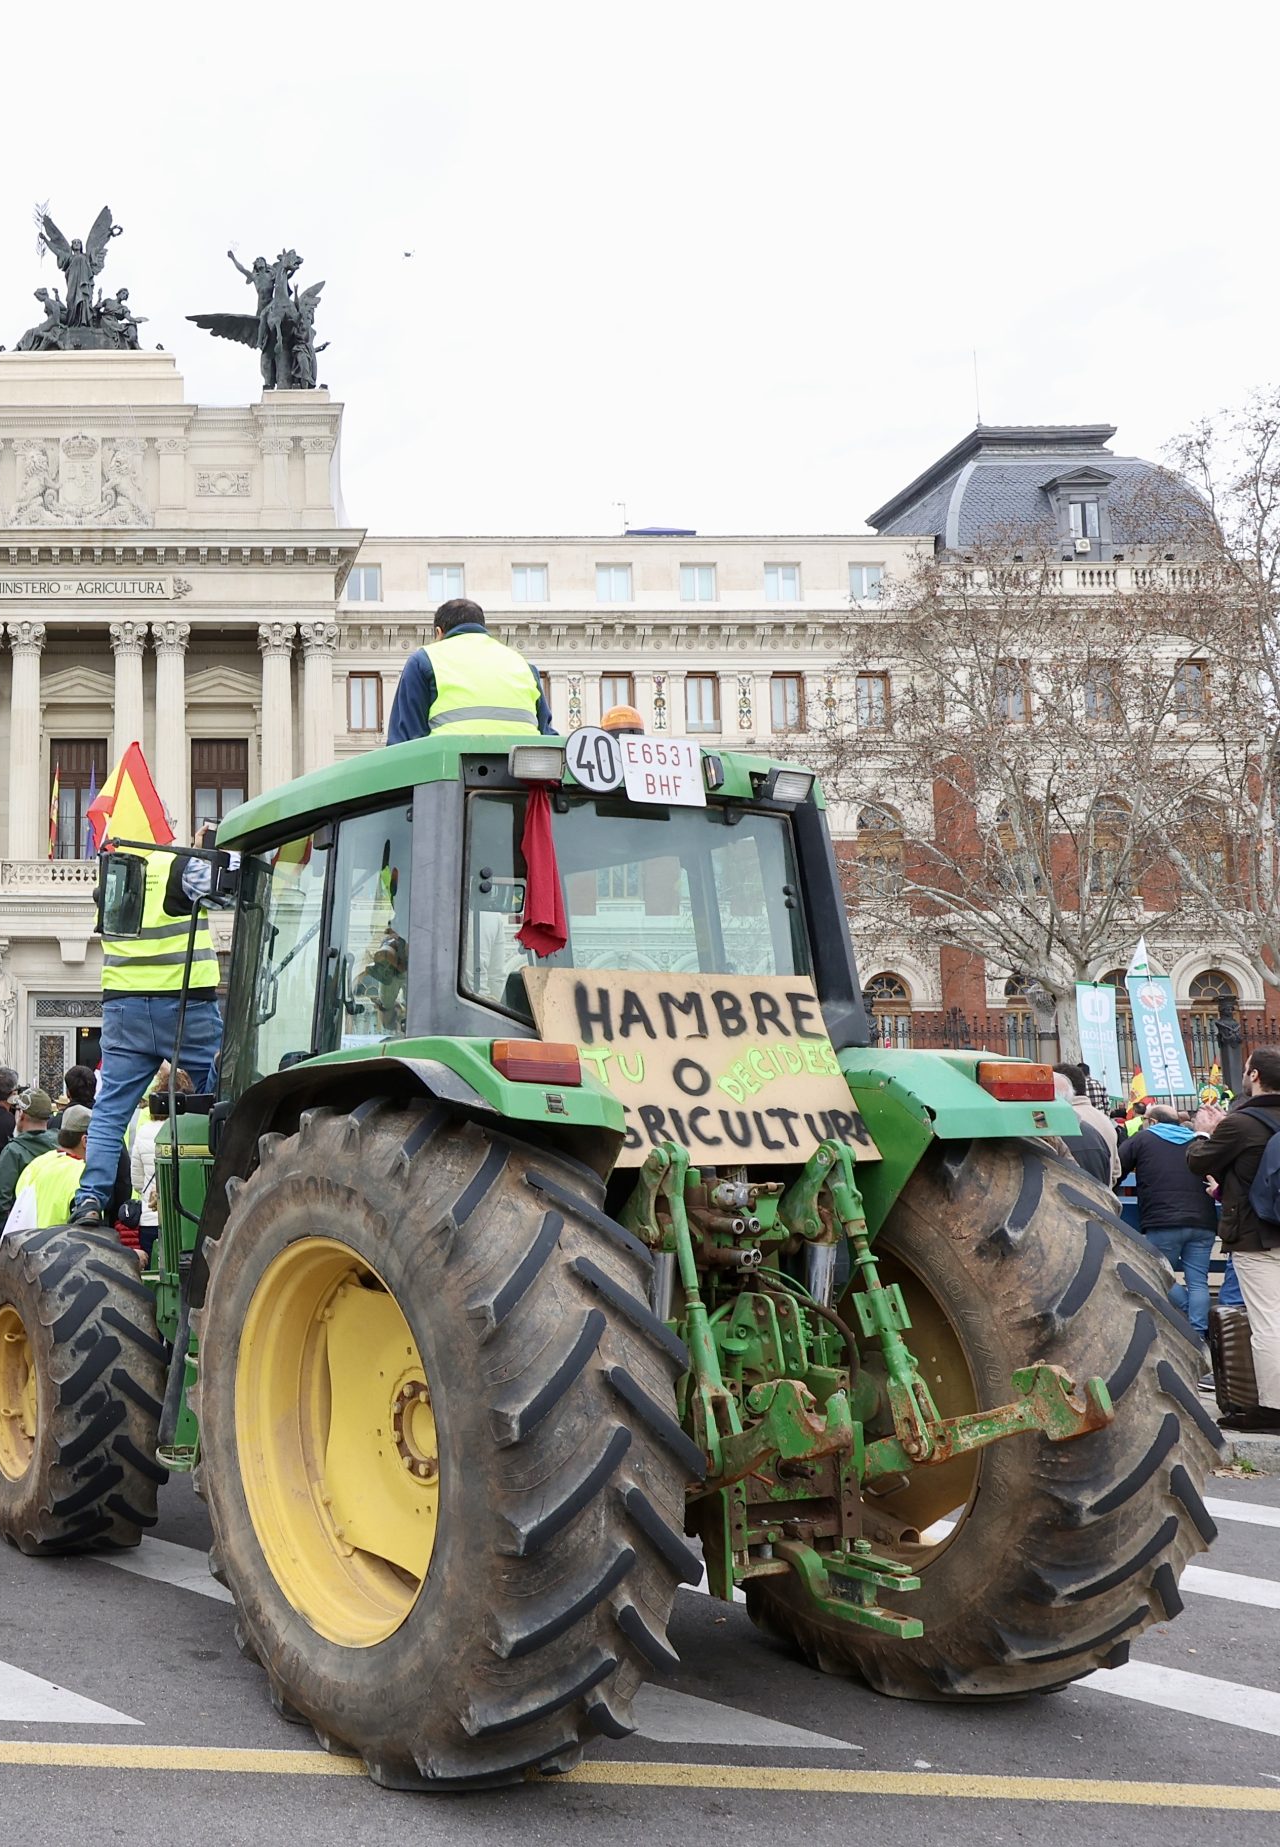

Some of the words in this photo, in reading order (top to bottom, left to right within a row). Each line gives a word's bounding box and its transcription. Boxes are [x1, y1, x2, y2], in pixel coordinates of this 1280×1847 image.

[75, 582, 165, 594] AGRICULTURA
[576, 735, 616, 783] 40
[626, 742, 693, 768] E6531
[645, 773, 682, 797] BHF
[574, 981, 828, 1045] HAMBRE
[580, 1047, 645, 1086] TU
[672, 1058, 711, 1097] O
[718, 1039, 842, 1105] DECIDES
